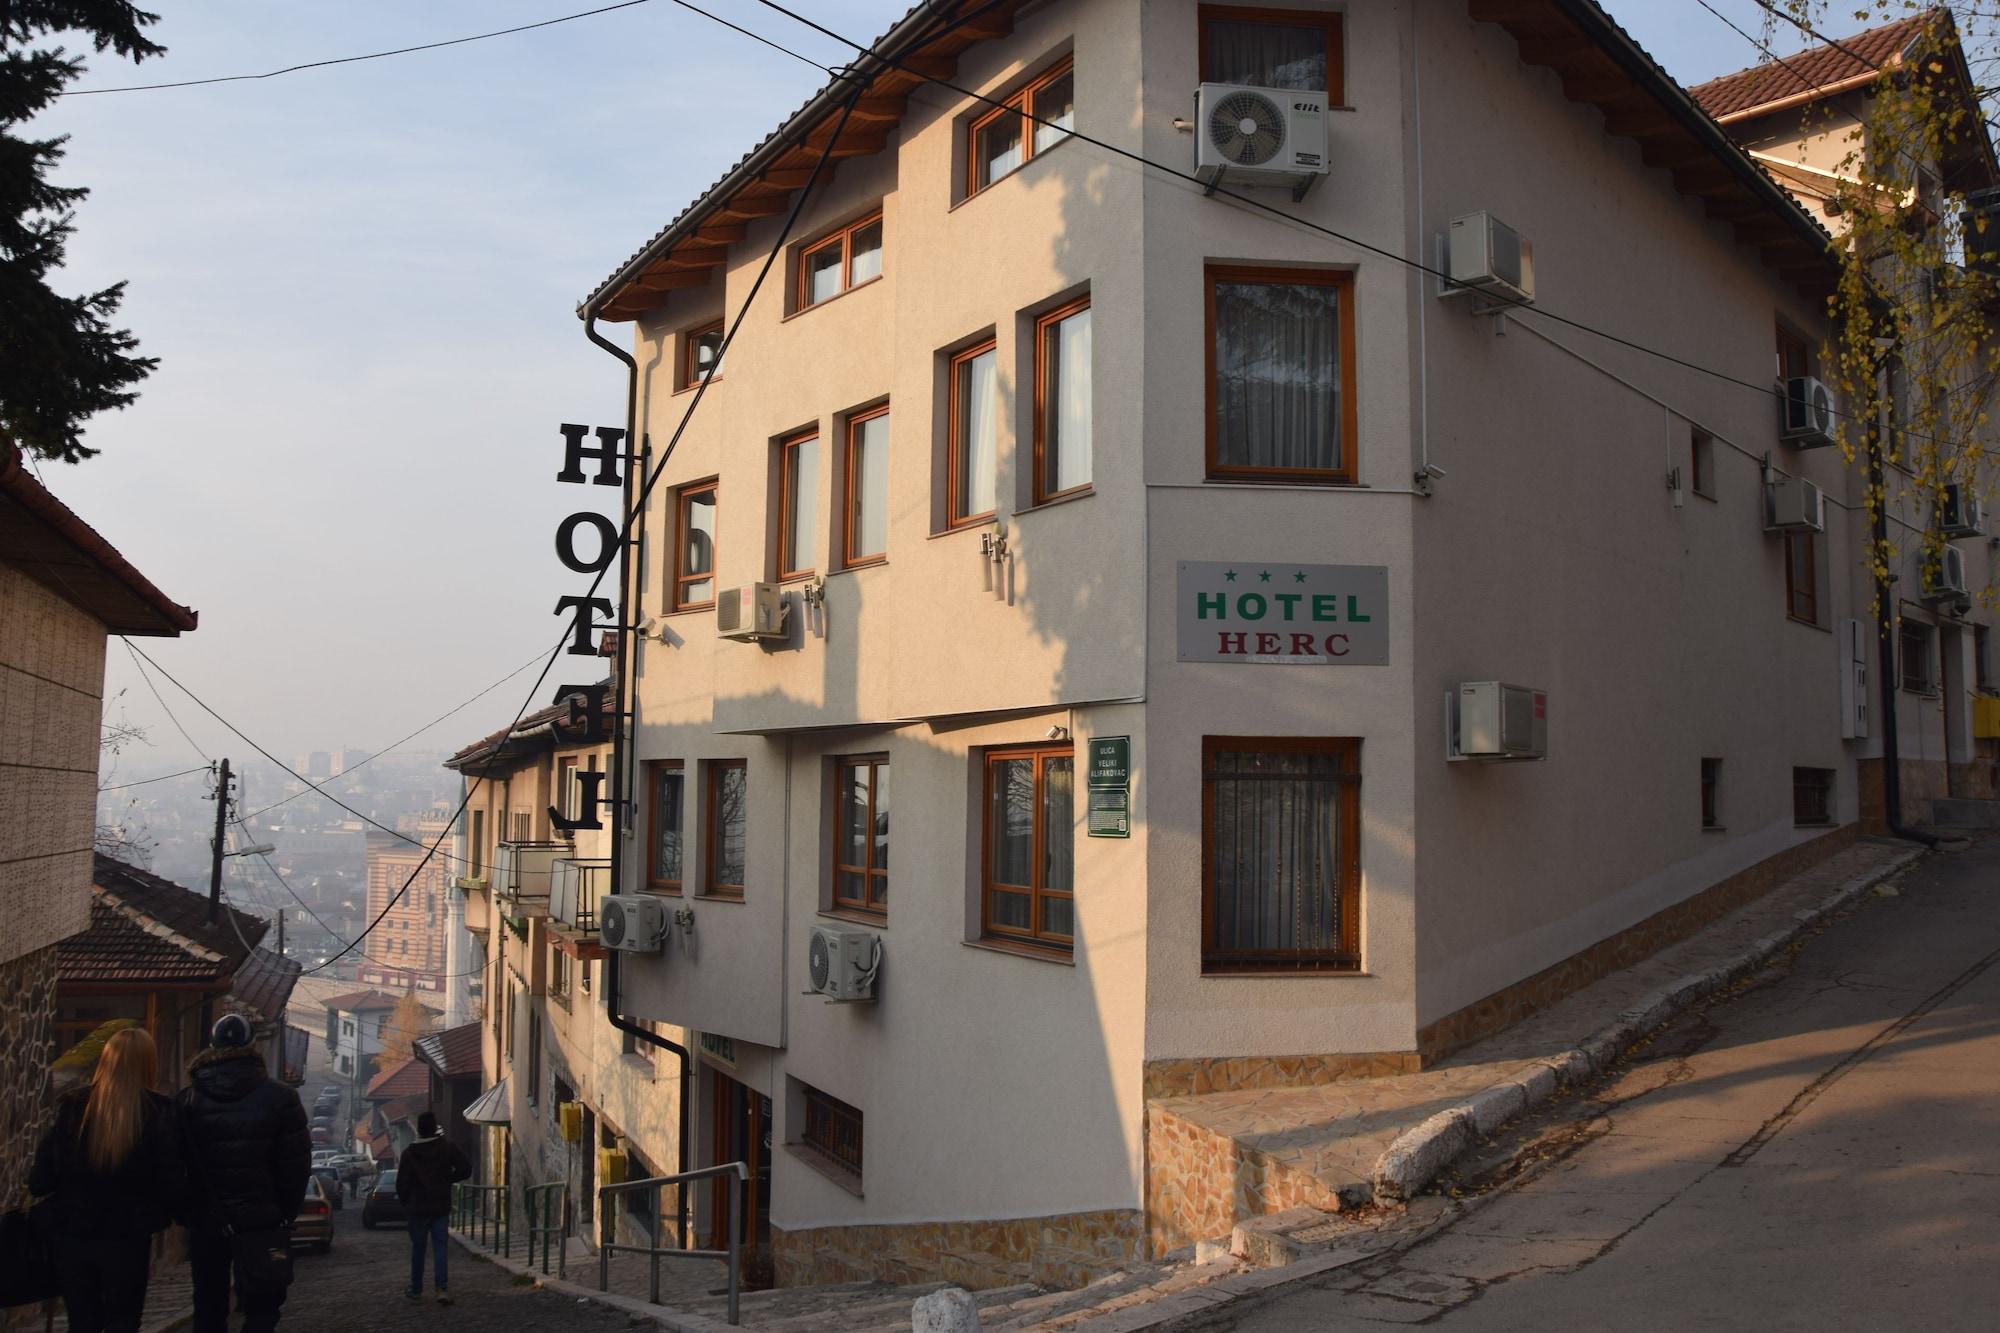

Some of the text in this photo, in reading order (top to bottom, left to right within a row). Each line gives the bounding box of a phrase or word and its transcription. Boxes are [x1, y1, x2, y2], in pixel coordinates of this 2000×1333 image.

[1197, 592, 1371, 622] HOTEL
[1218, 632, 1350, 657] HERC
[1099, 746, 1116, 755] ULICA
[1098, 759, 1117, 768] VELIKI
[1090, 768, 1126, 778] ALIFAKOVAC
